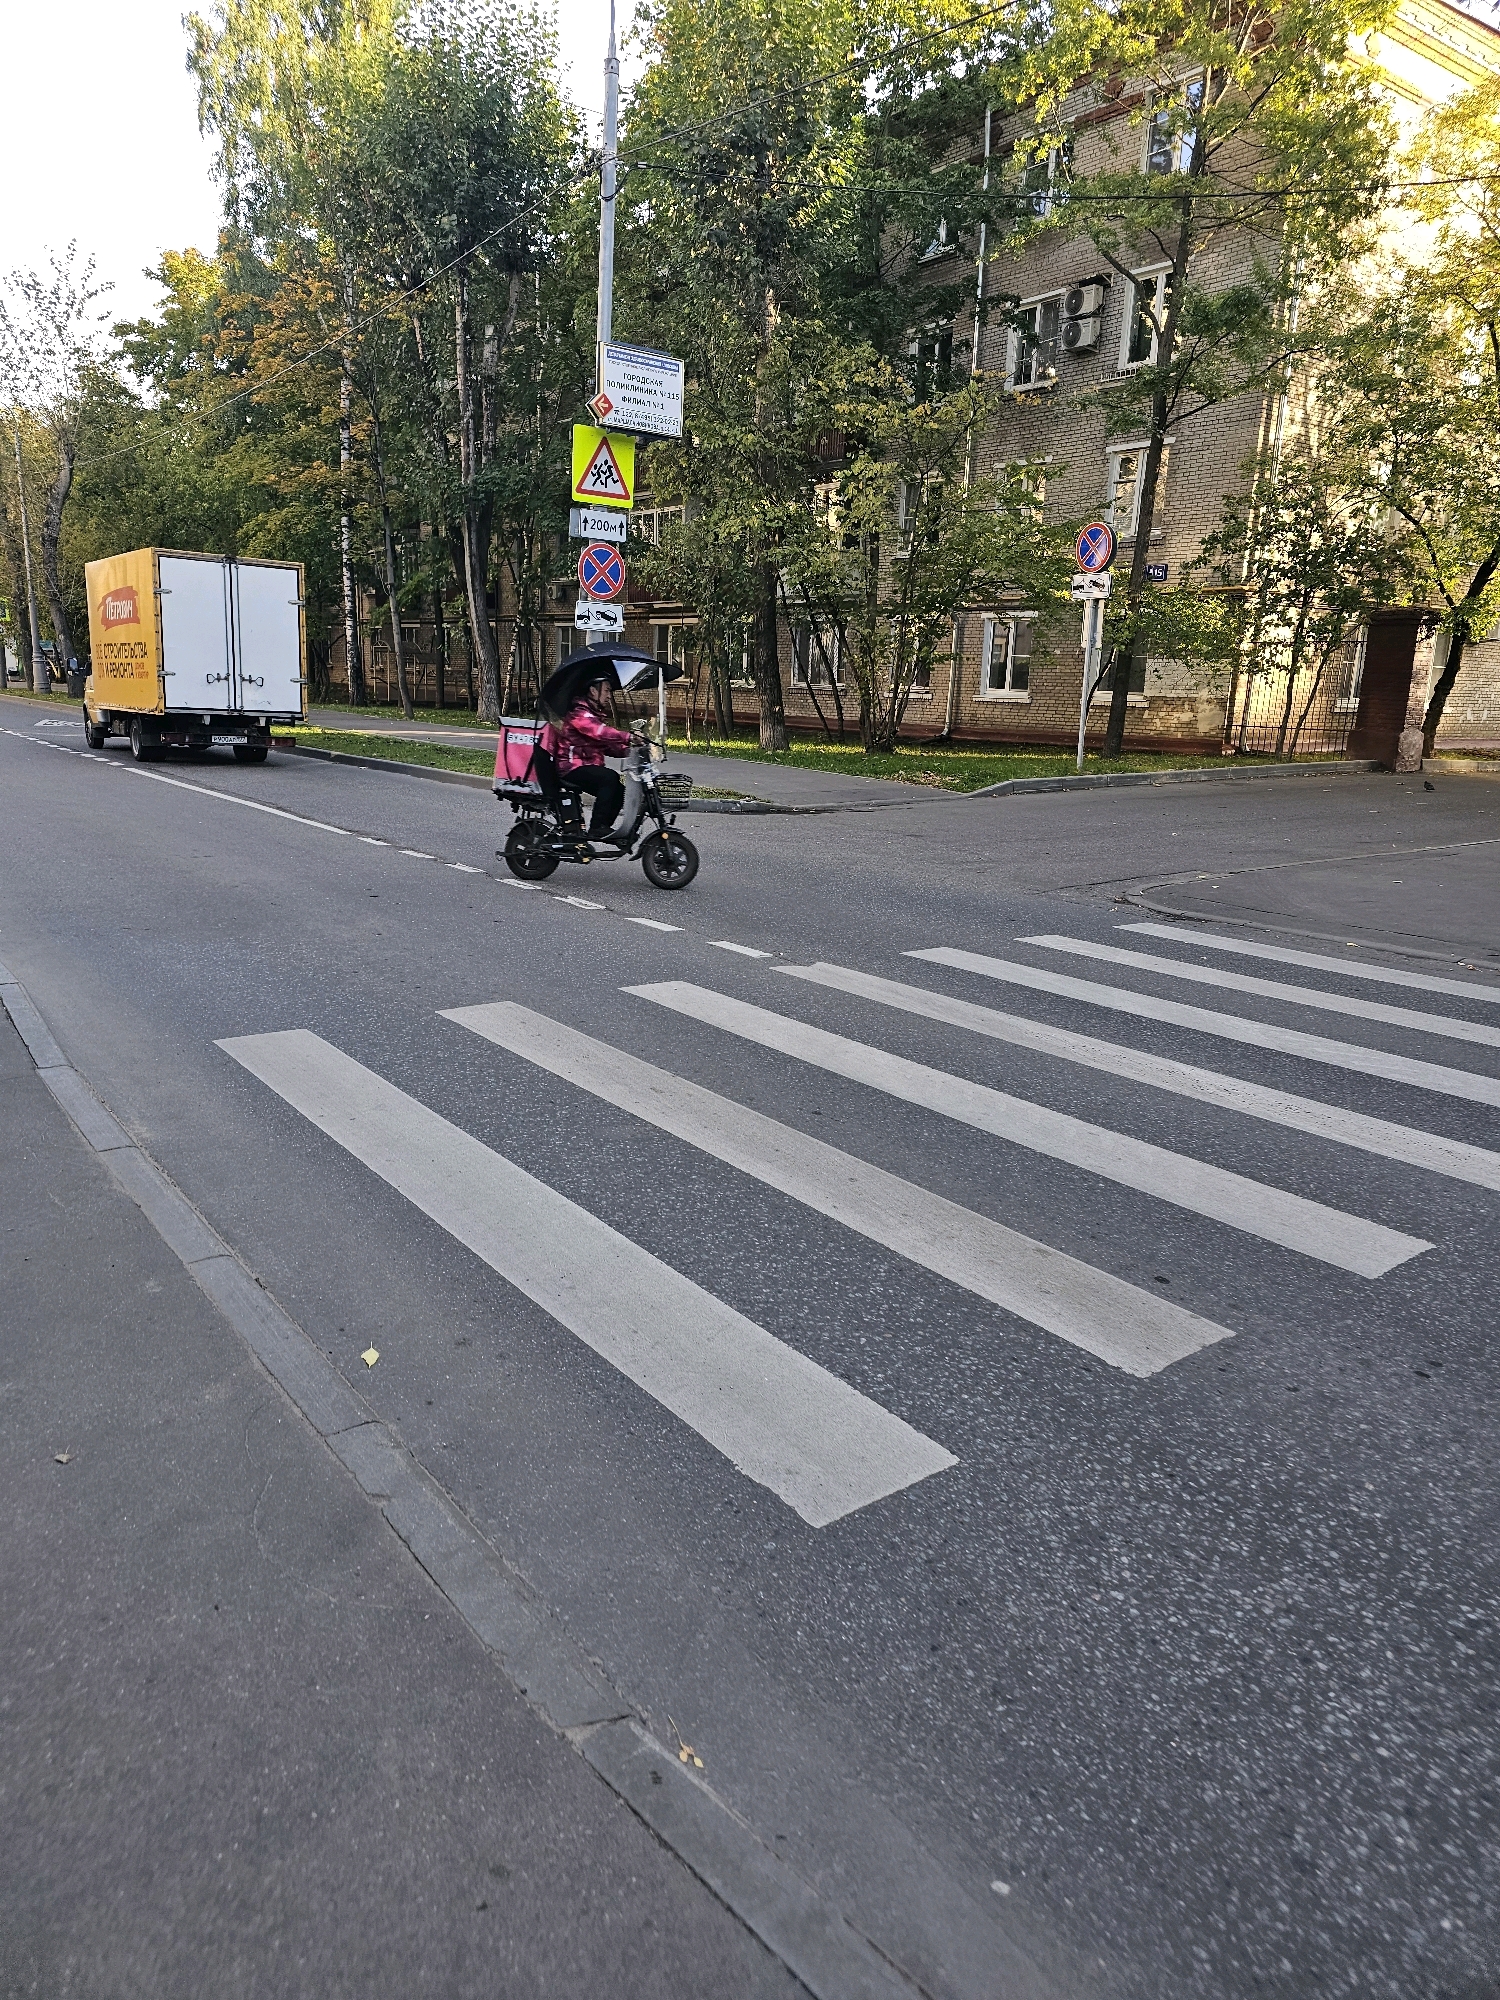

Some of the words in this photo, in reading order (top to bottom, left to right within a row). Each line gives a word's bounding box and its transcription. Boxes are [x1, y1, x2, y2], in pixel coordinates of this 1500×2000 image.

[606, 379, 658, 396] ПОЛИКЛИНИКА
[623, 373, 663, 387] ГОРОДСКАЯ
[621, 395, 651, 408] ФИЛИАЛ
[590, 518, 617, 533] 200м
[103, 642, 149, 659] СТРОИТЕЛЬСТВА
[109, 662, 135, 679] РЕМОНТА
